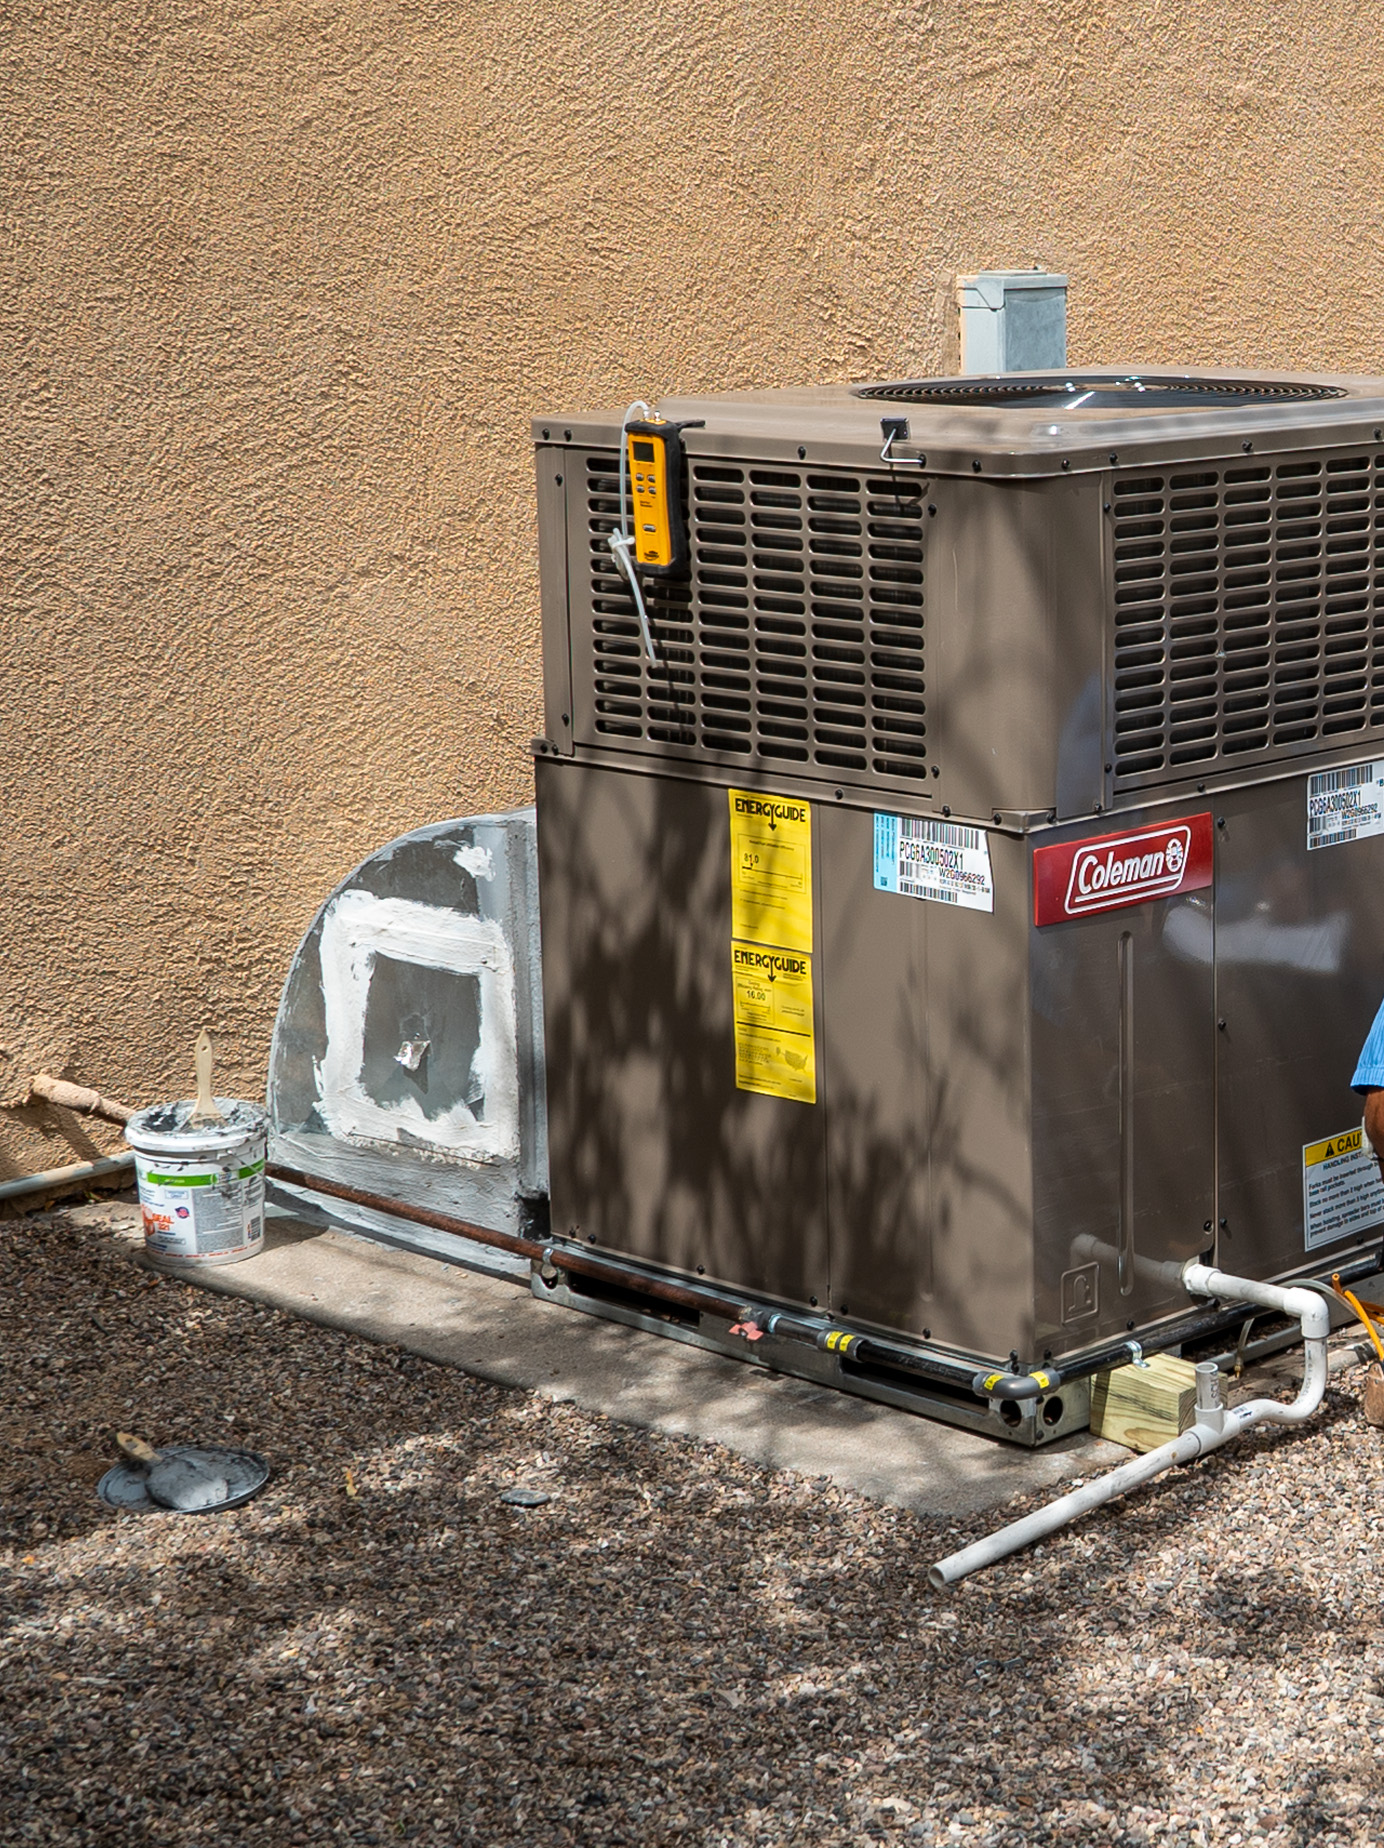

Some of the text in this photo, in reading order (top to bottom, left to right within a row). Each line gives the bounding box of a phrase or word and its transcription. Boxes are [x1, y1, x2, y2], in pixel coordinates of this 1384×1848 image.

[735, 797, 806, 823] ENERGYGUIDE
[1079, 851, 1164, 894] Coleman
[734, 949, 807, 975] ENERGYGUIDE
[1338, 1133, 1362, 1151] CAU
